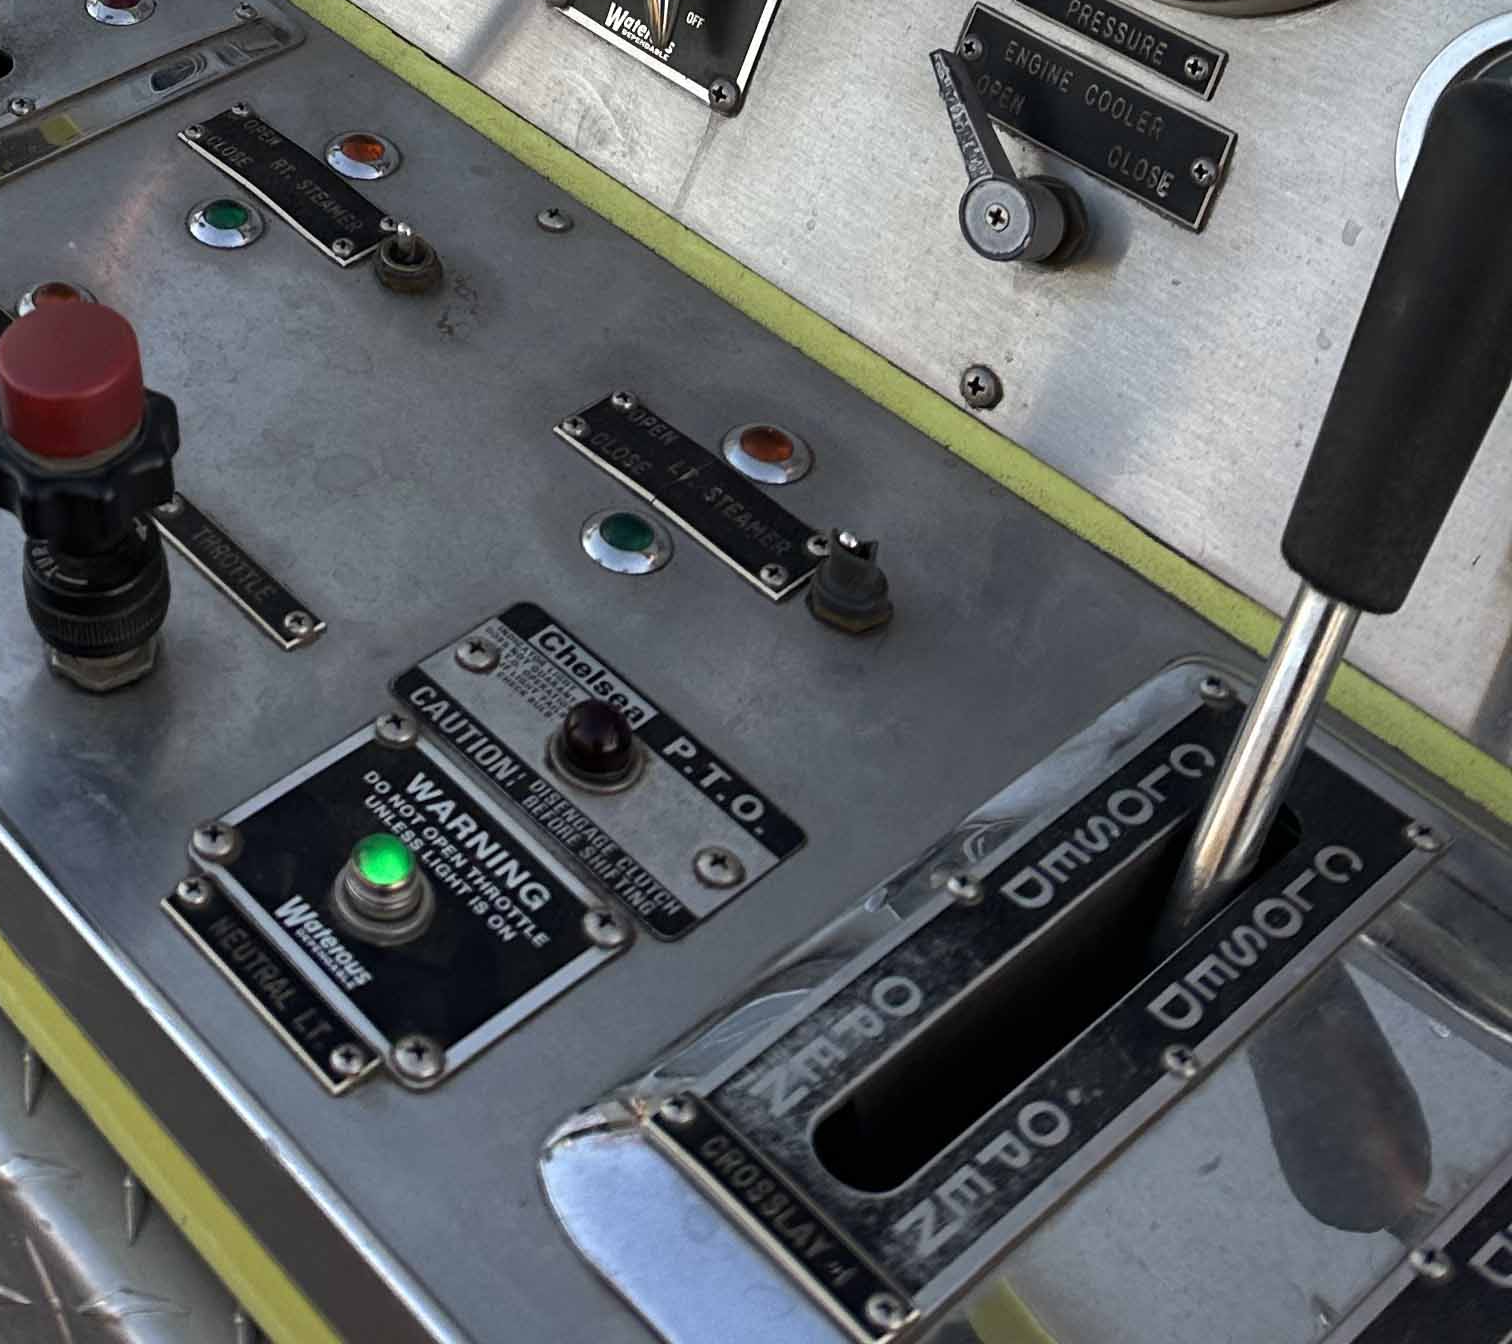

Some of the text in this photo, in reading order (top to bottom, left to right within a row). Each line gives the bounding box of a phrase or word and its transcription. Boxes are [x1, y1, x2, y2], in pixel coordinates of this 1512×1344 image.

[605, 1, 676, 55] Waters
[686, 11, 705, 29] OFF
[243, 119, 283, 146] OPEN
[976, 75, 1026, 116] OPEN
[1004, 40, 1165, 140] ENGINE COOLER
[207, 135, 255, 169] CLOSE
[1108, 145, 1176, 199] CLOSE
[296, 178, 363, 232] STEAMER
[590, 431, 652, 474] CLOSE
[629, 411, 680, 446] OPEN
[191, 526, 280, 603] THROTTLE
[704, 487, 791, 553] STEAMER
[537, 630, 645, 727] Chelsea
[662, 736, 765, 836] P.T.O.
[1000, 743, 1216, 910] CLOSED
[363, 770, 551, 948] DO NOT OPEN THROTTLE
[363, 795, 518, 944] UNLESS LIGHT IS ON
[406, 772, 552, 912] WARNING
[522, 794, 658, 916] BEFORE SHIFTING
[529, 779, 684, 916] DISENGAGE CLUTCH
[208, 915, 298, 1012] NEUTRAL
[274, 894, 374, 988] Waterous
[1145, 845, 1365, 1031] CLOSED
[751, 975, 924, 1118] OPEN
[703, 1134, 833, 1260] CROSSLAY
[892, 1100, 1071, 1259] OPEN
